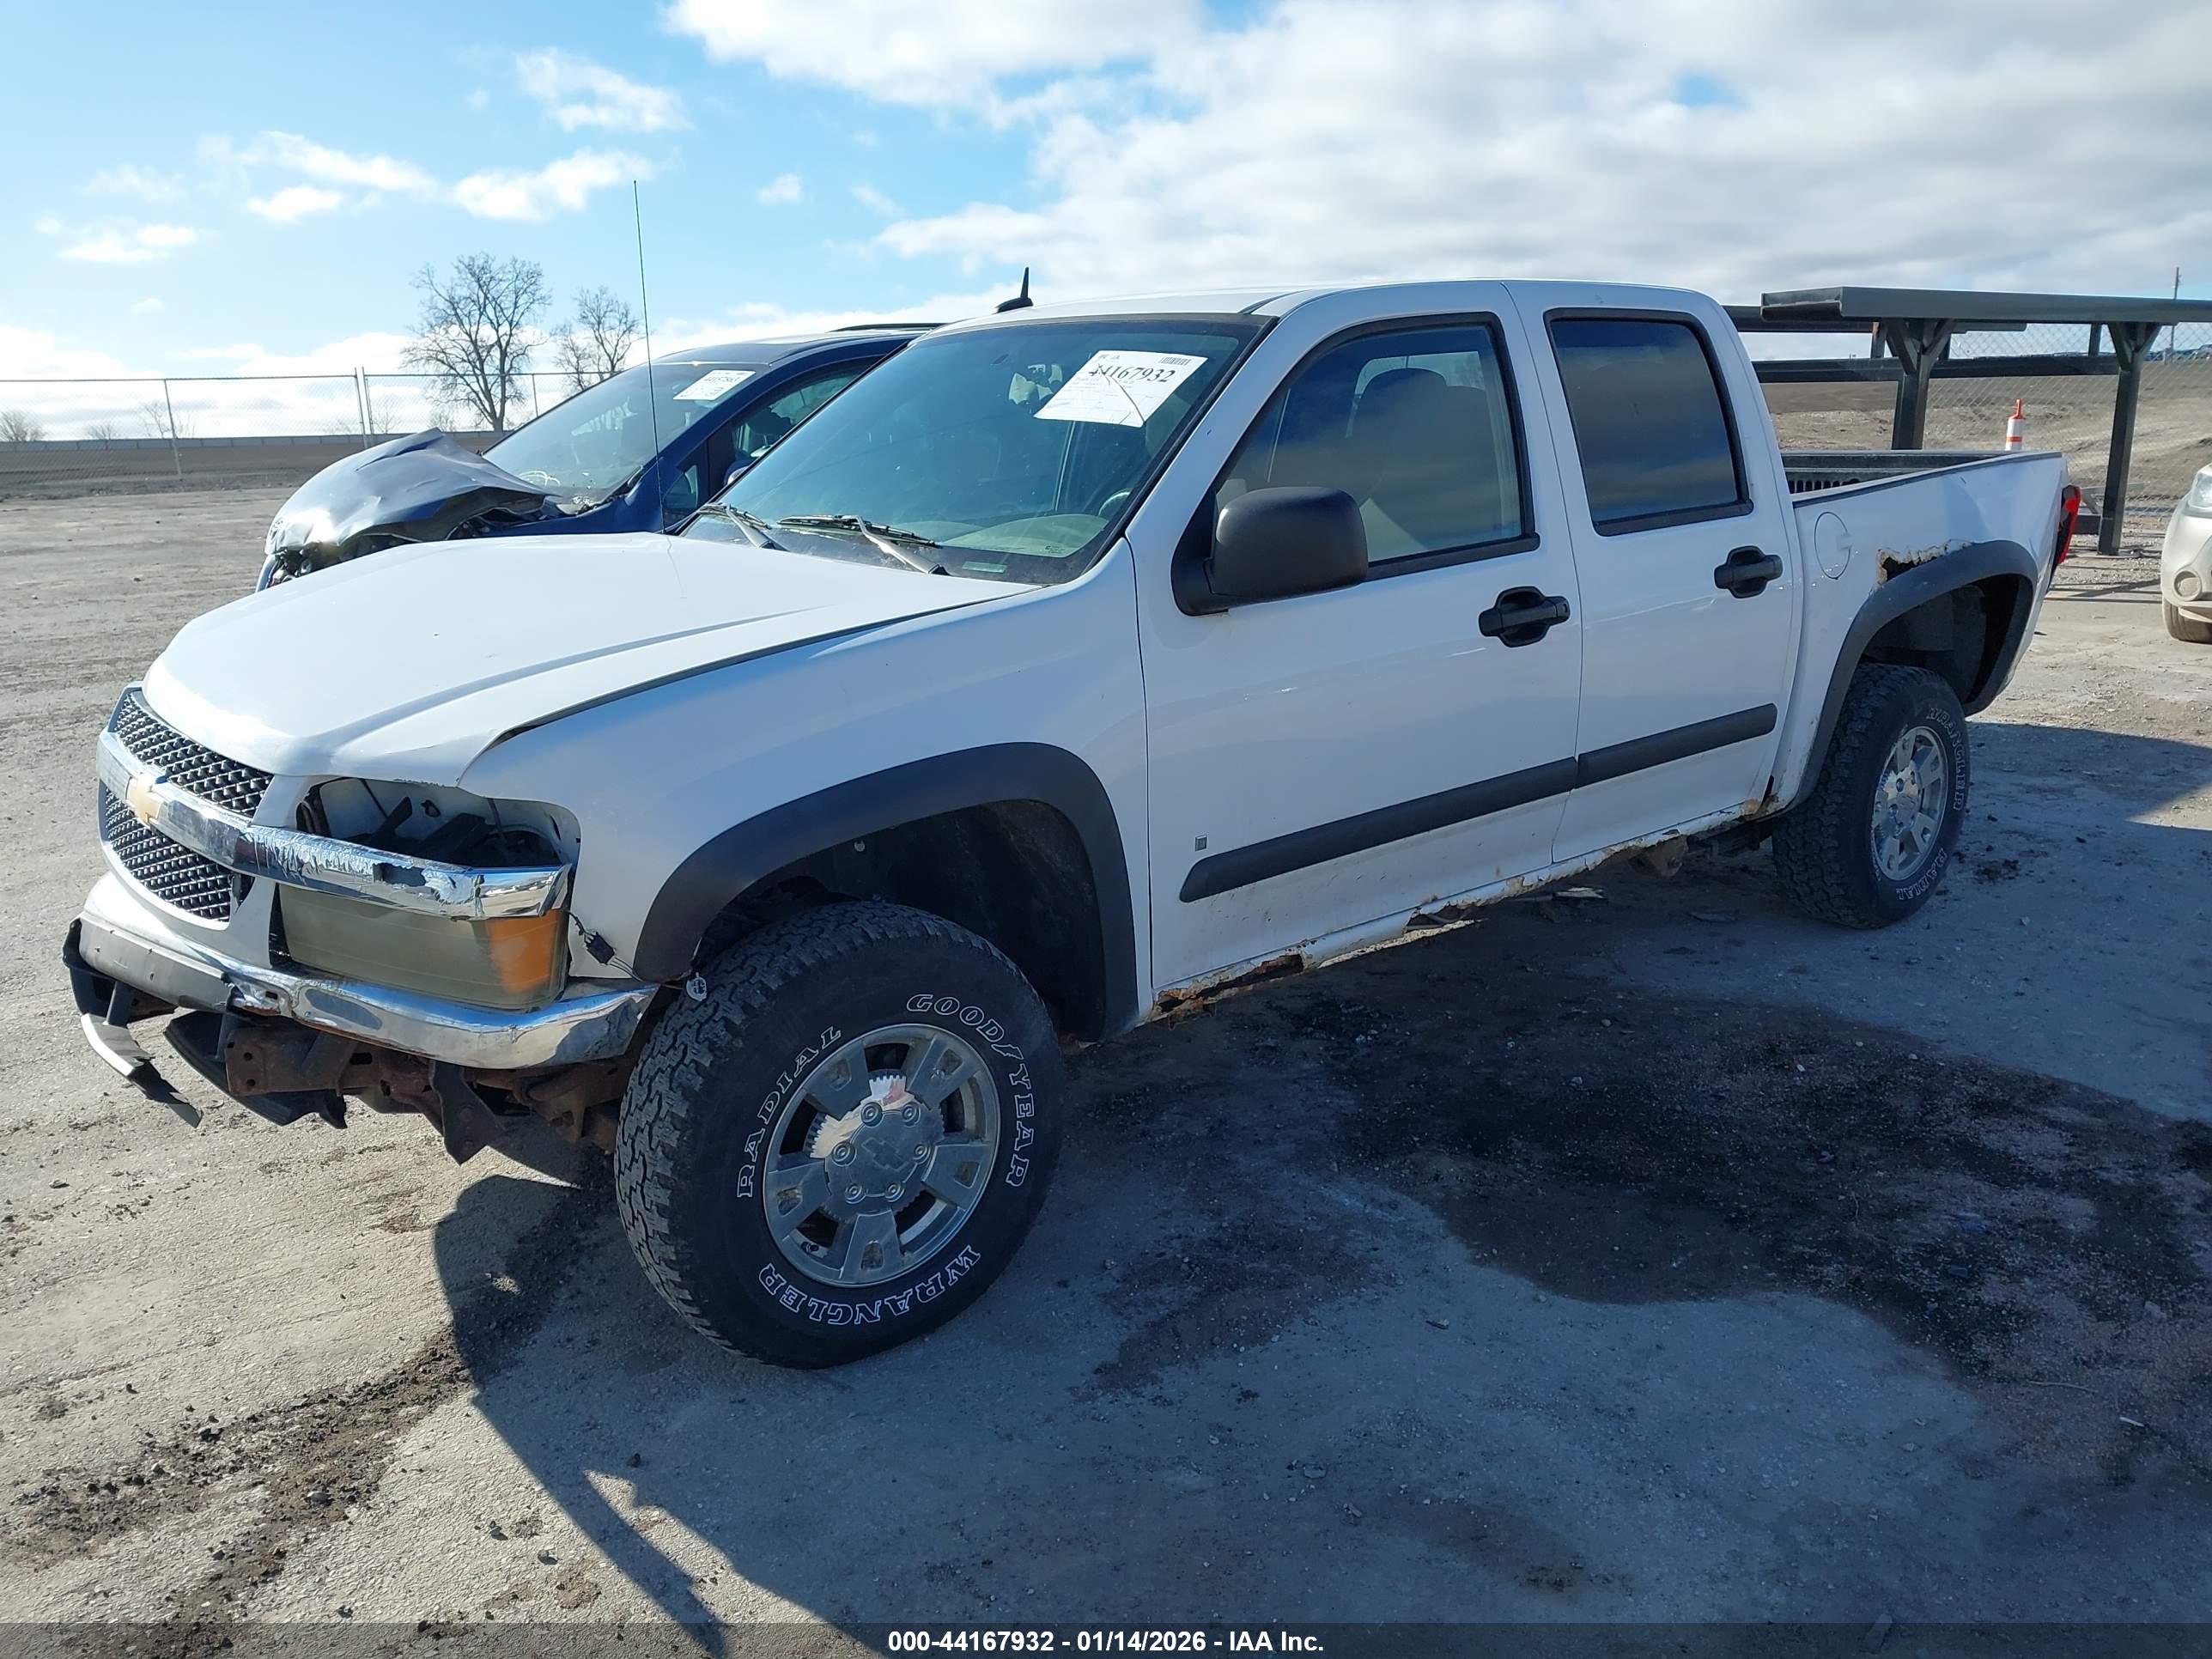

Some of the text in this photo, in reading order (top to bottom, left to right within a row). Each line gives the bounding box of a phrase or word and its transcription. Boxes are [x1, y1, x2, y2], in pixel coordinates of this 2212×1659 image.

[1896, 848, 1948, 900] RADIAL
[737, 1026, 842, 1198] RADIAL
[906, 994, 1035, 1188] GOODYEAR
[758, 1245, 981, 1325] WRANGLER
